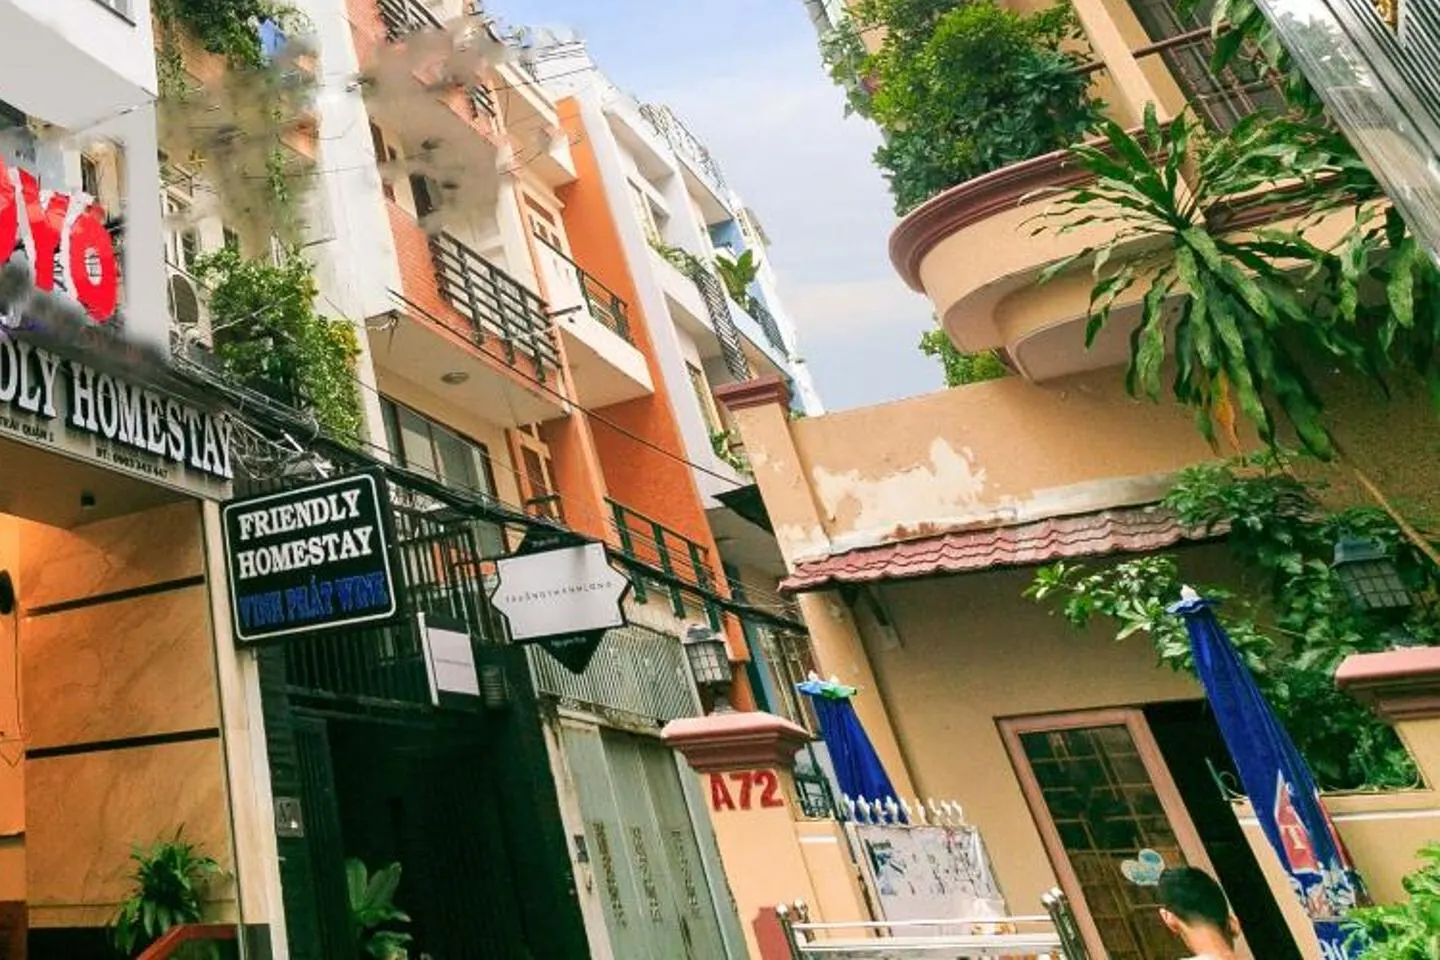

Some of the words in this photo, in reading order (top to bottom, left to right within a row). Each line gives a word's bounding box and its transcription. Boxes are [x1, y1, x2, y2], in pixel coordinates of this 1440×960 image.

[70, 361, 234, 479] HOMESTAY
[237, 488, 361, 540] FRIENDLY
[236, 526, 373, 579] HOMESTAY
[709, 768, 784, 812] A72
